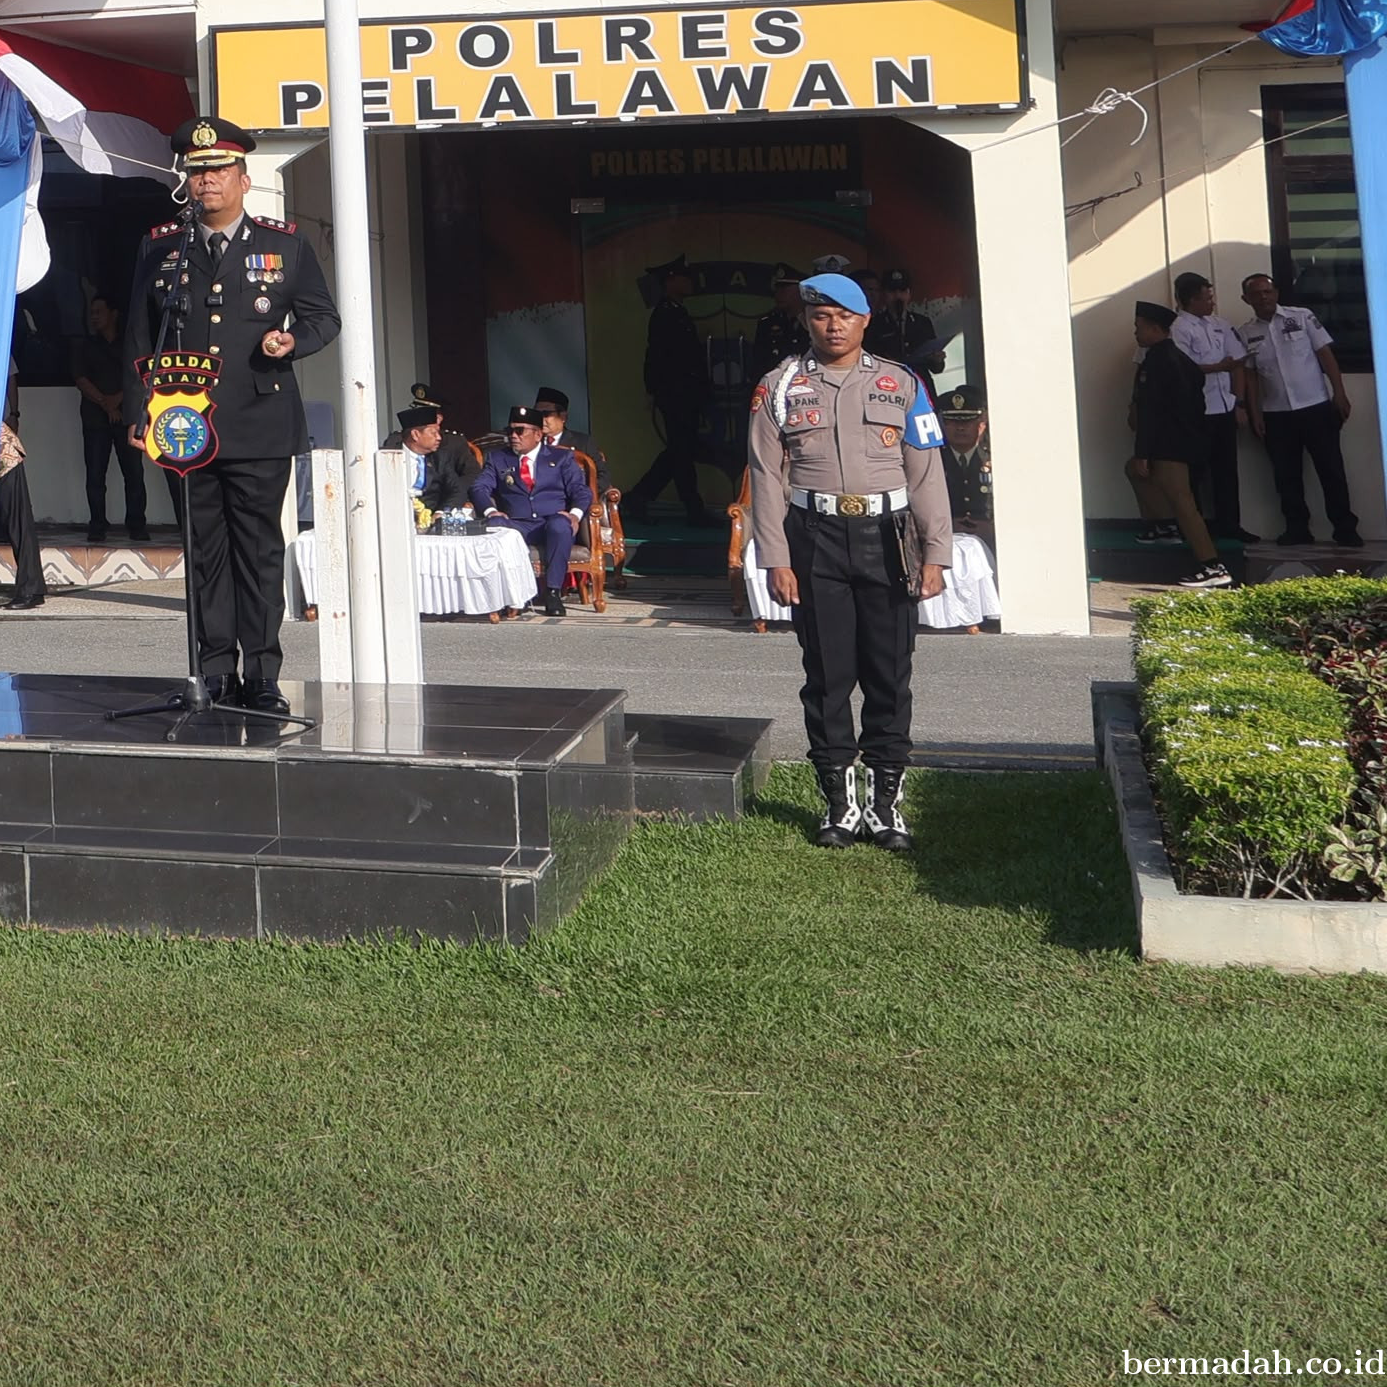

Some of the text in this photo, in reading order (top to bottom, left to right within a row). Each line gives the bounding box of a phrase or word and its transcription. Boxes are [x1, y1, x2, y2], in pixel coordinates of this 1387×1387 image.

[391, 10, 801, 70] POLRES
[282, 59, 929, 125] PELALAWAN
[590, 143, 848, 178] POLRES PELALAWAN
[153, 374, 206, 386] RIAU
[868, 393, 906, 407] POLRI
